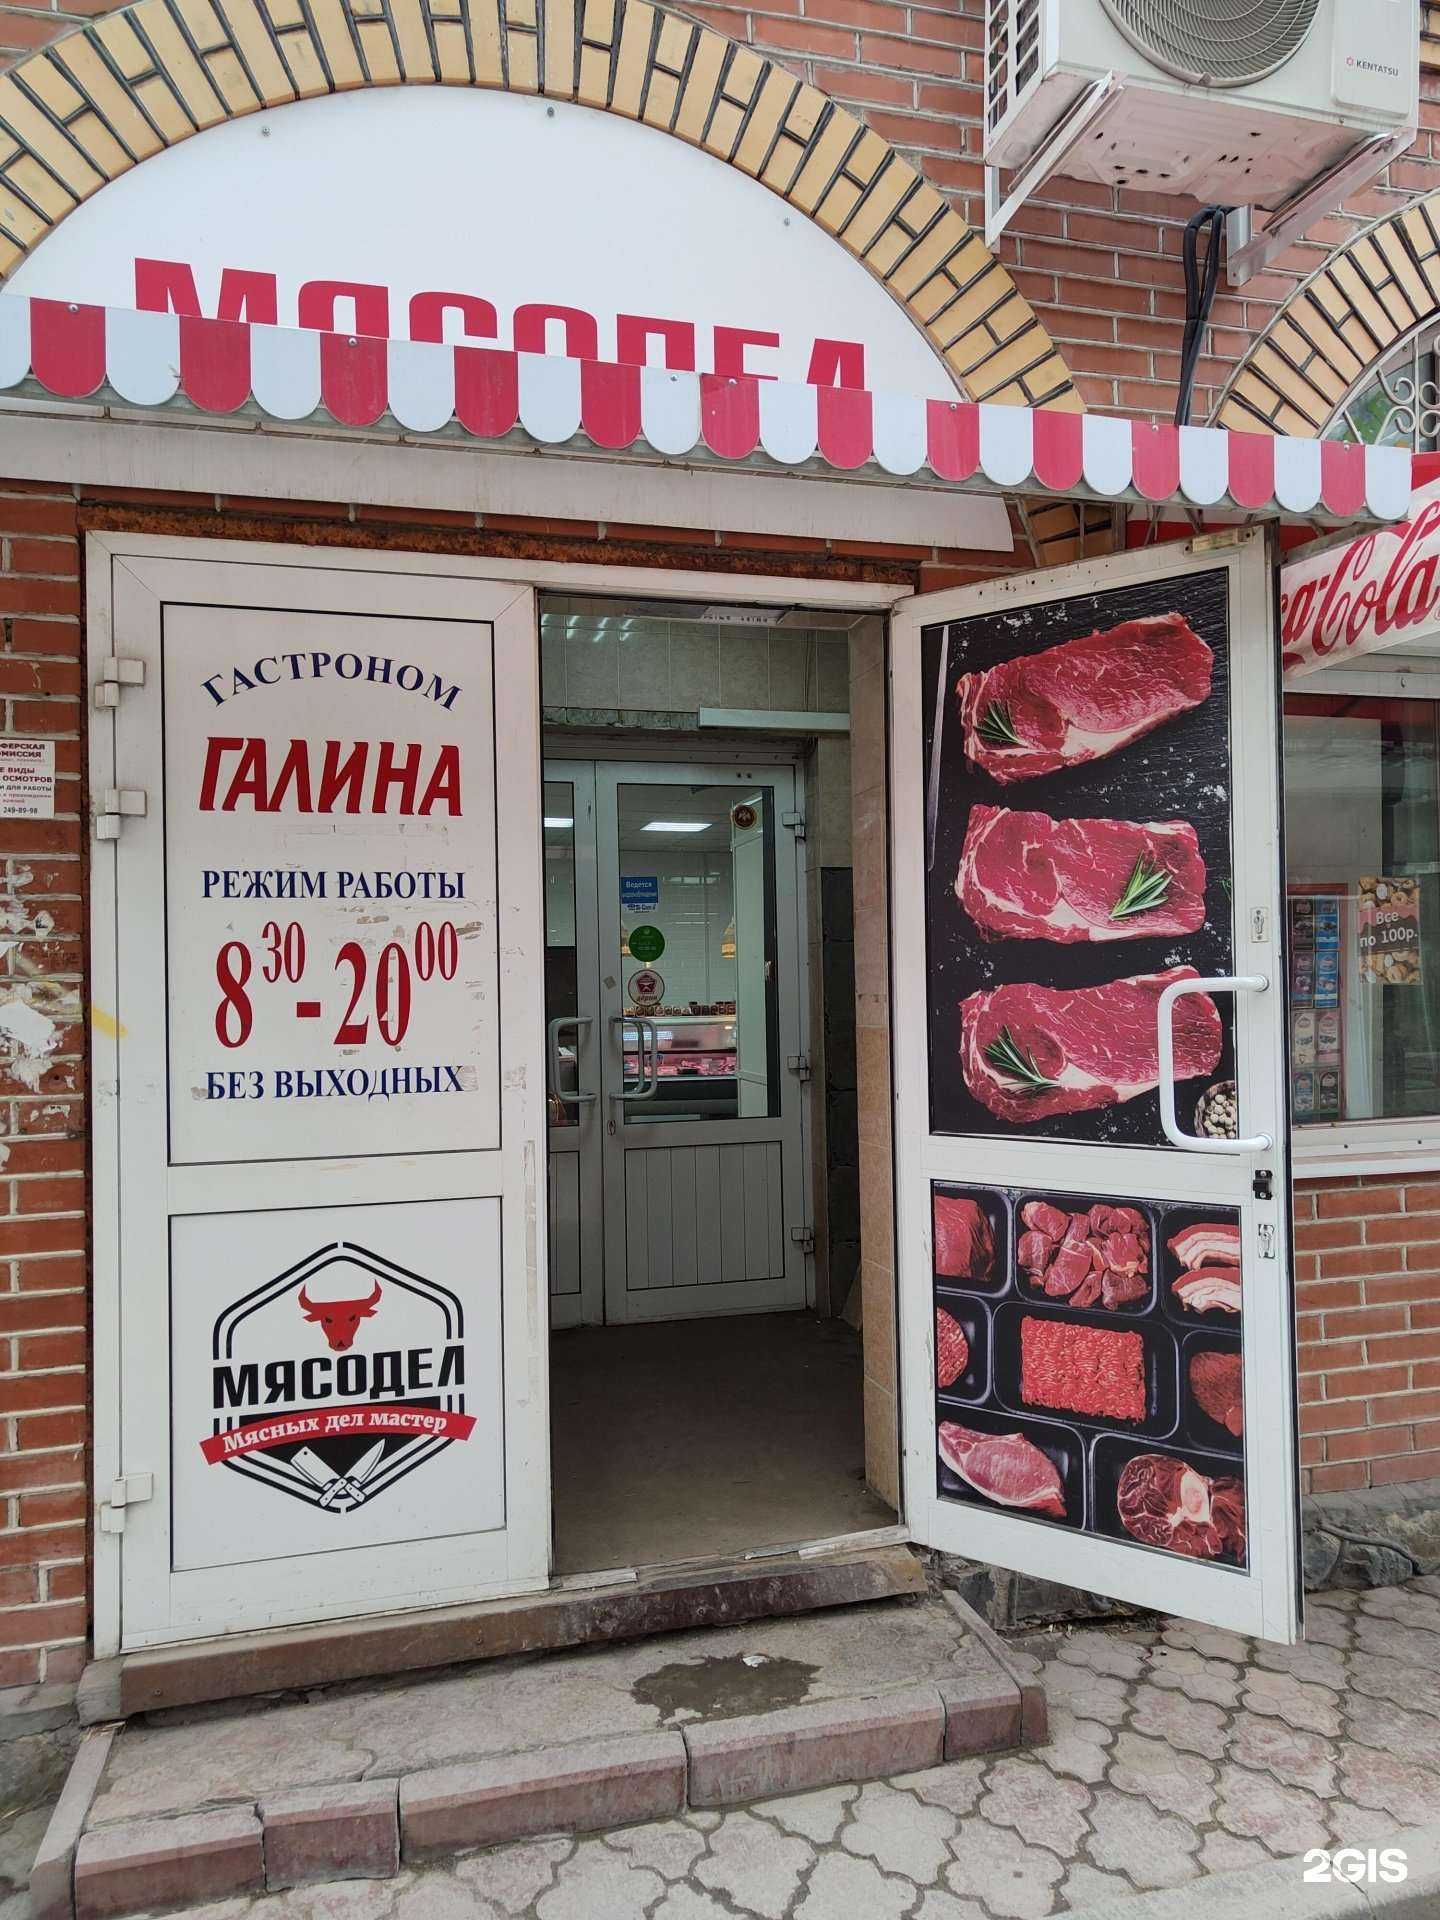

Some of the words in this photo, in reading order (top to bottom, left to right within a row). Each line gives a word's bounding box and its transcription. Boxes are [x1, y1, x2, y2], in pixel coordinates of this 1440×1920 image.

[1356, 59, 1399, 76] KENTATSU
[200, 652, 463, 711] ГАСТРОНОМ
[0, 750, 41, 758] МИССИЯ
[2, 775, 53, 783] ОСМОТРОВ
[199, 737, 463, 816] ГАЛИНА
[202, 871, 326, 898] РЕЖИМ
[337, 871, 466, 899] РАБОТЫ
[1376, 912, 1399, 924] Все
[1360, 936, 1376, 947] по
[205, 1071, 264, 1100] БЕЗ
[275, 1066, 464, 1102] ВЫХОДНЫХ
[213, 1345, 465, 1409] МЯСОДЕЛ
[222, 1417, 319, 1453] Мясных
[325, 1412, 364, 1432] дел
[369, 1411, 447, 1432] мастер
